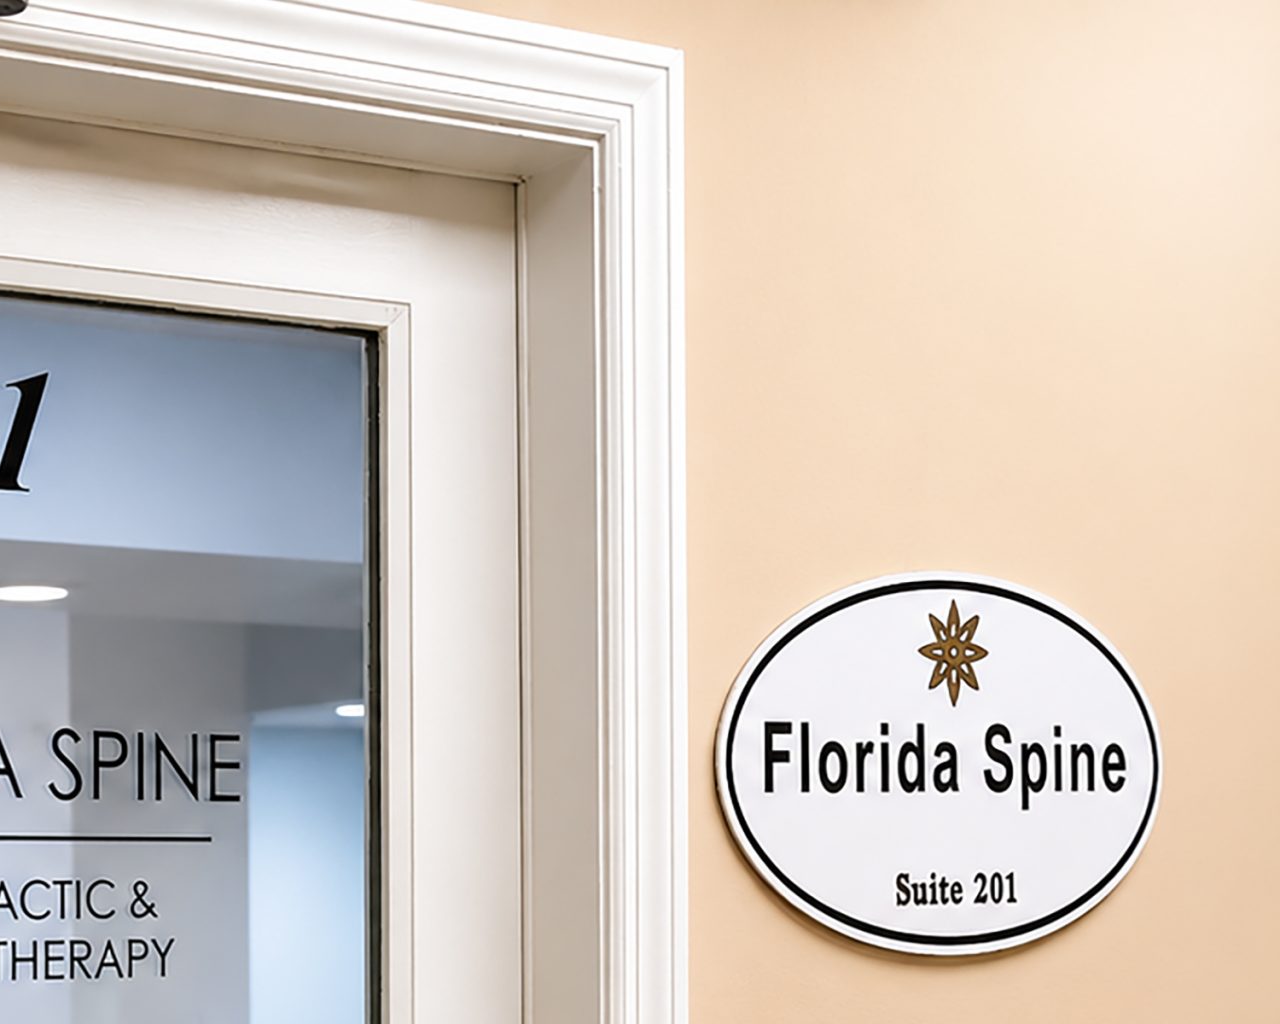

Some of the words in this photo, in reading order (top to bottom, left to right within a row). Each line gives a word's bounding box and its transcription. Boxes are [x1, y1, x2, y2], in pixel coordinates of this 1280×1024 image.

[48, 727, 242, 803] SPINE
[763, 720, 960, 794] Florida
[983, 723, 1127, 811] Spine
[130, 880, 158, 919] &
[895, 873, 964, 907] Suite
[973, 872, 1017, 904] 201
